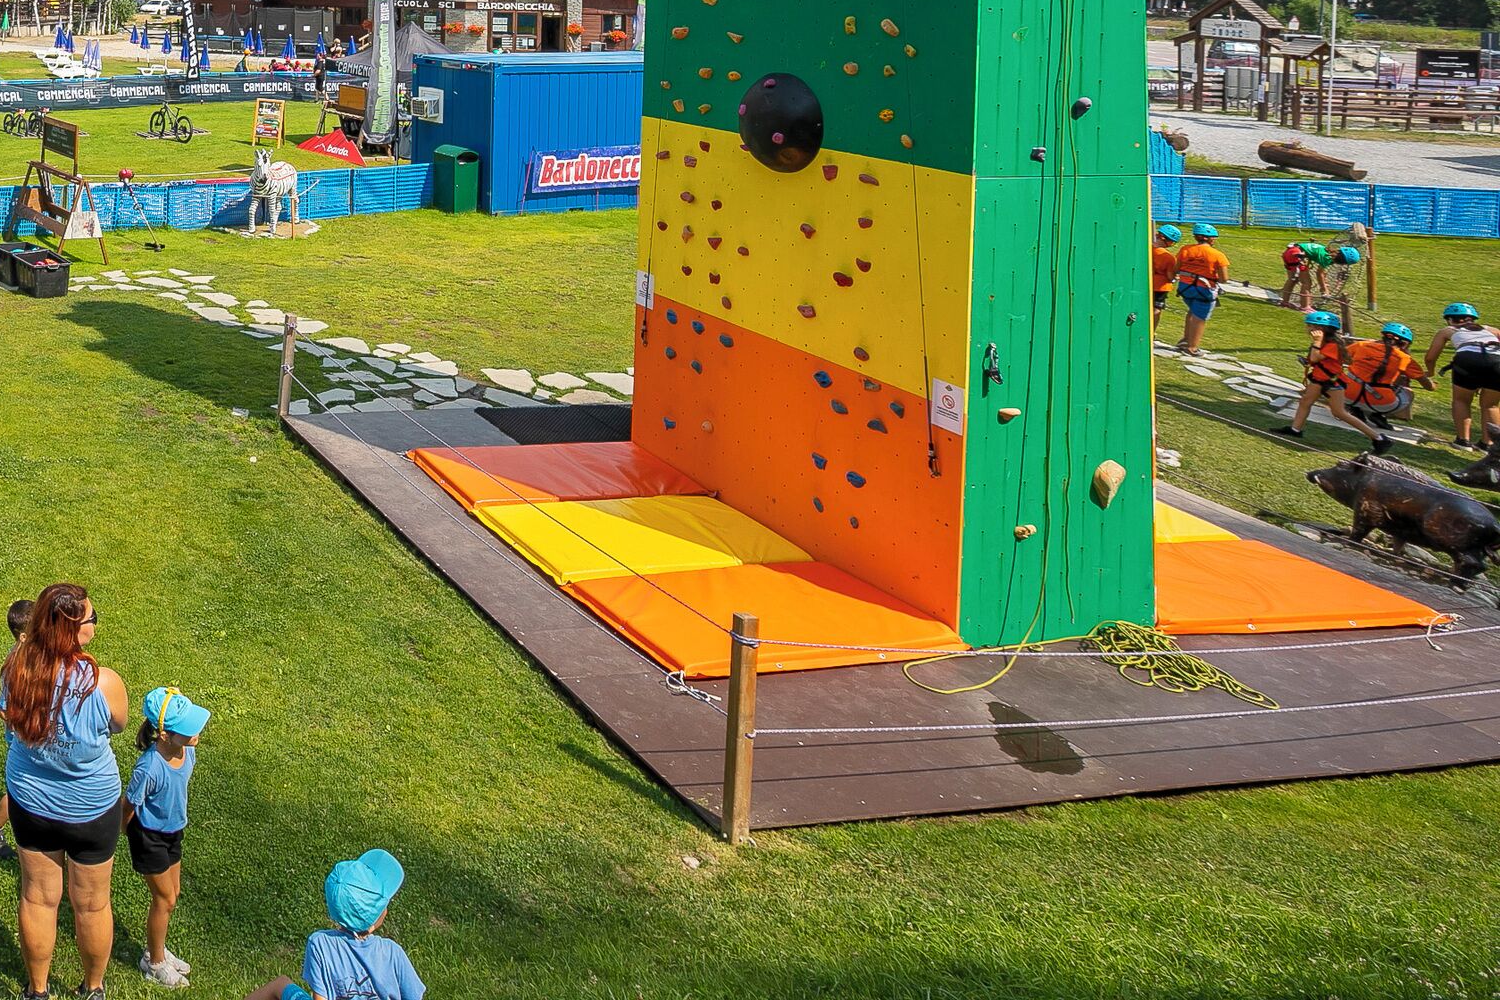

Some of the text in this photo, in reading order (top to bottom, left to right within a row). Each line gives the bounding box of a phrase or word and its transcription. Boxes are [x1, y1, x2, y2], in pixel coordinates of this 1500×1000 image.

[438, 1, 456, 9] SCI
[477, 2, 555, 11] BARDONECCHIA
[337, 61, 372, 77] COMMENC
[109, 86, 166, 98] COMMENCAL
[179, 82, 231, 94] COMMENCAL
[243, 82, 293, 93] COMMENCAL
[37, 88, 97, 100] COMMENCAL
[539, 154, 640, 186] Bardonecc
